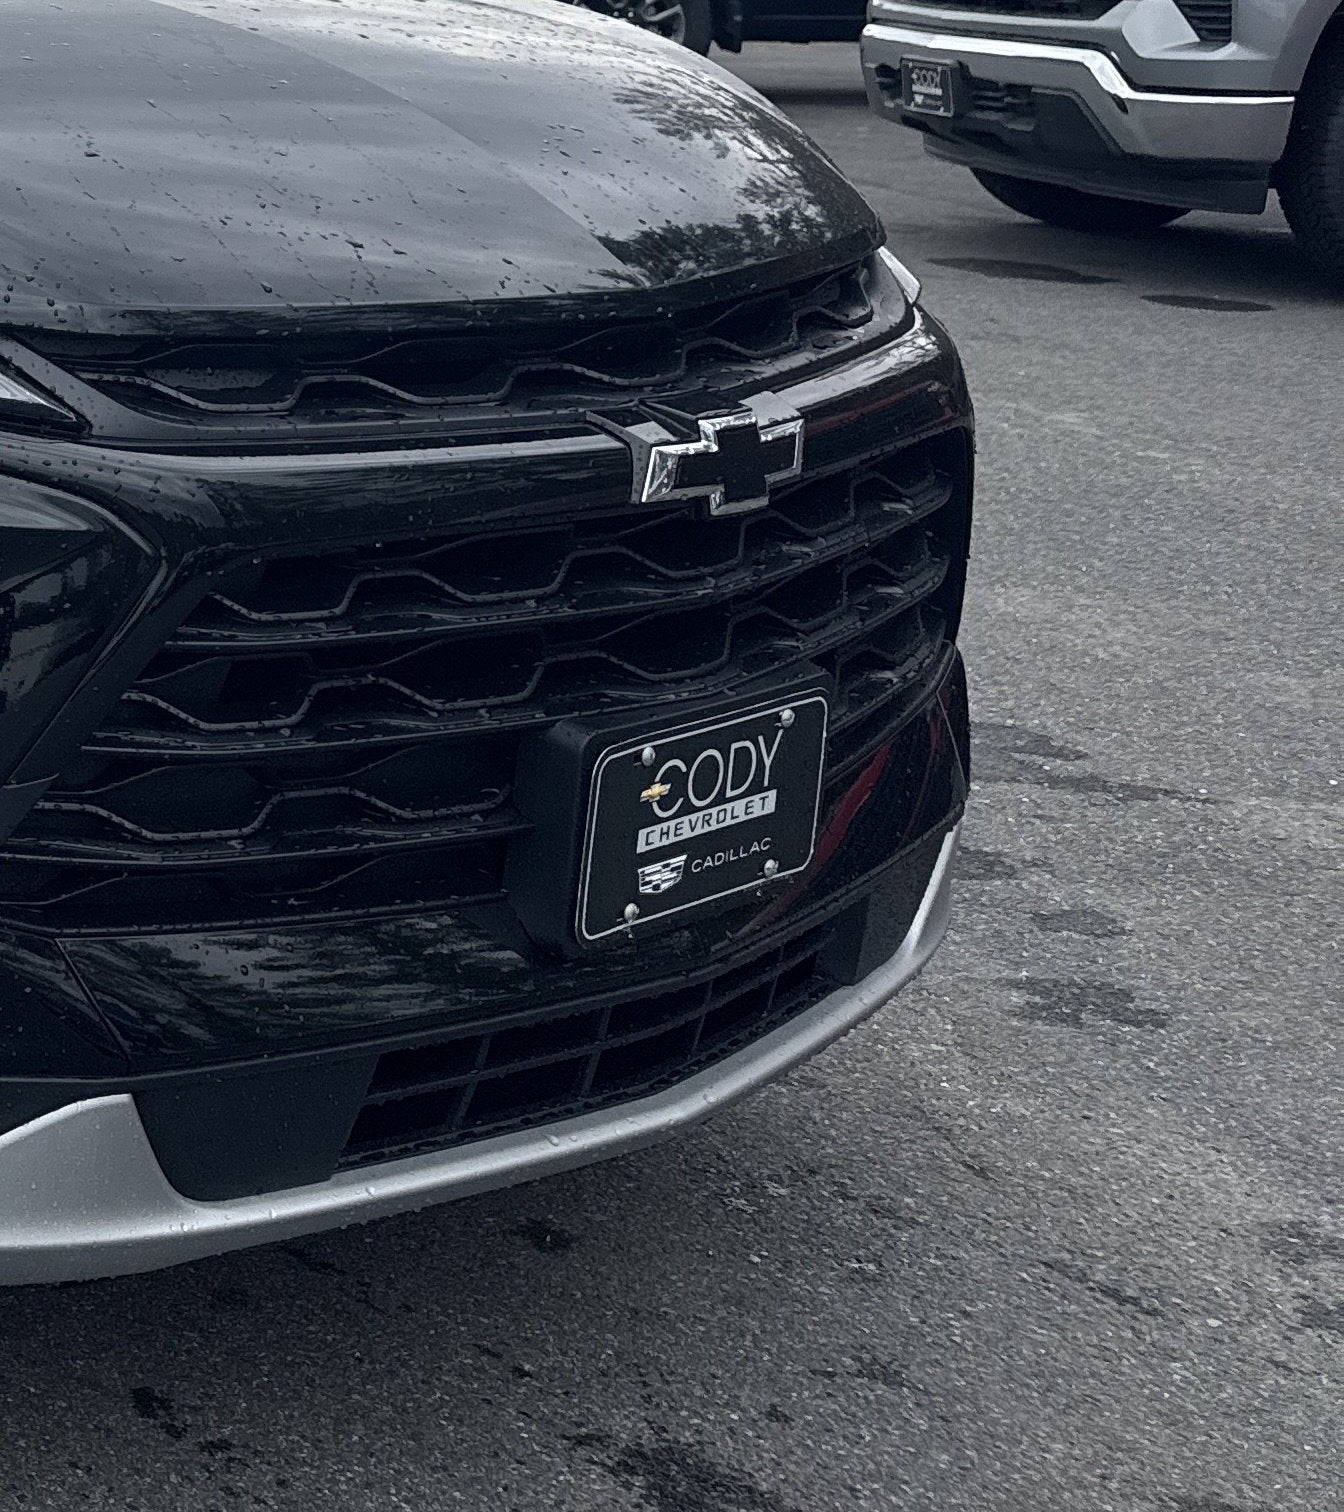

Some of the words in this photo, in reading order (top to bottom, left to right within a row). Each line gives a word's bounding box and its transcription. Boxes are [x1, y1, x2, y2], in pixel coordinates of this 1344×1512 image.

[652, 728, 784, 818] CODY
[644, 795, 770, 848] CHEVROLET
[691, 837, 772, 873] CADILLAC
